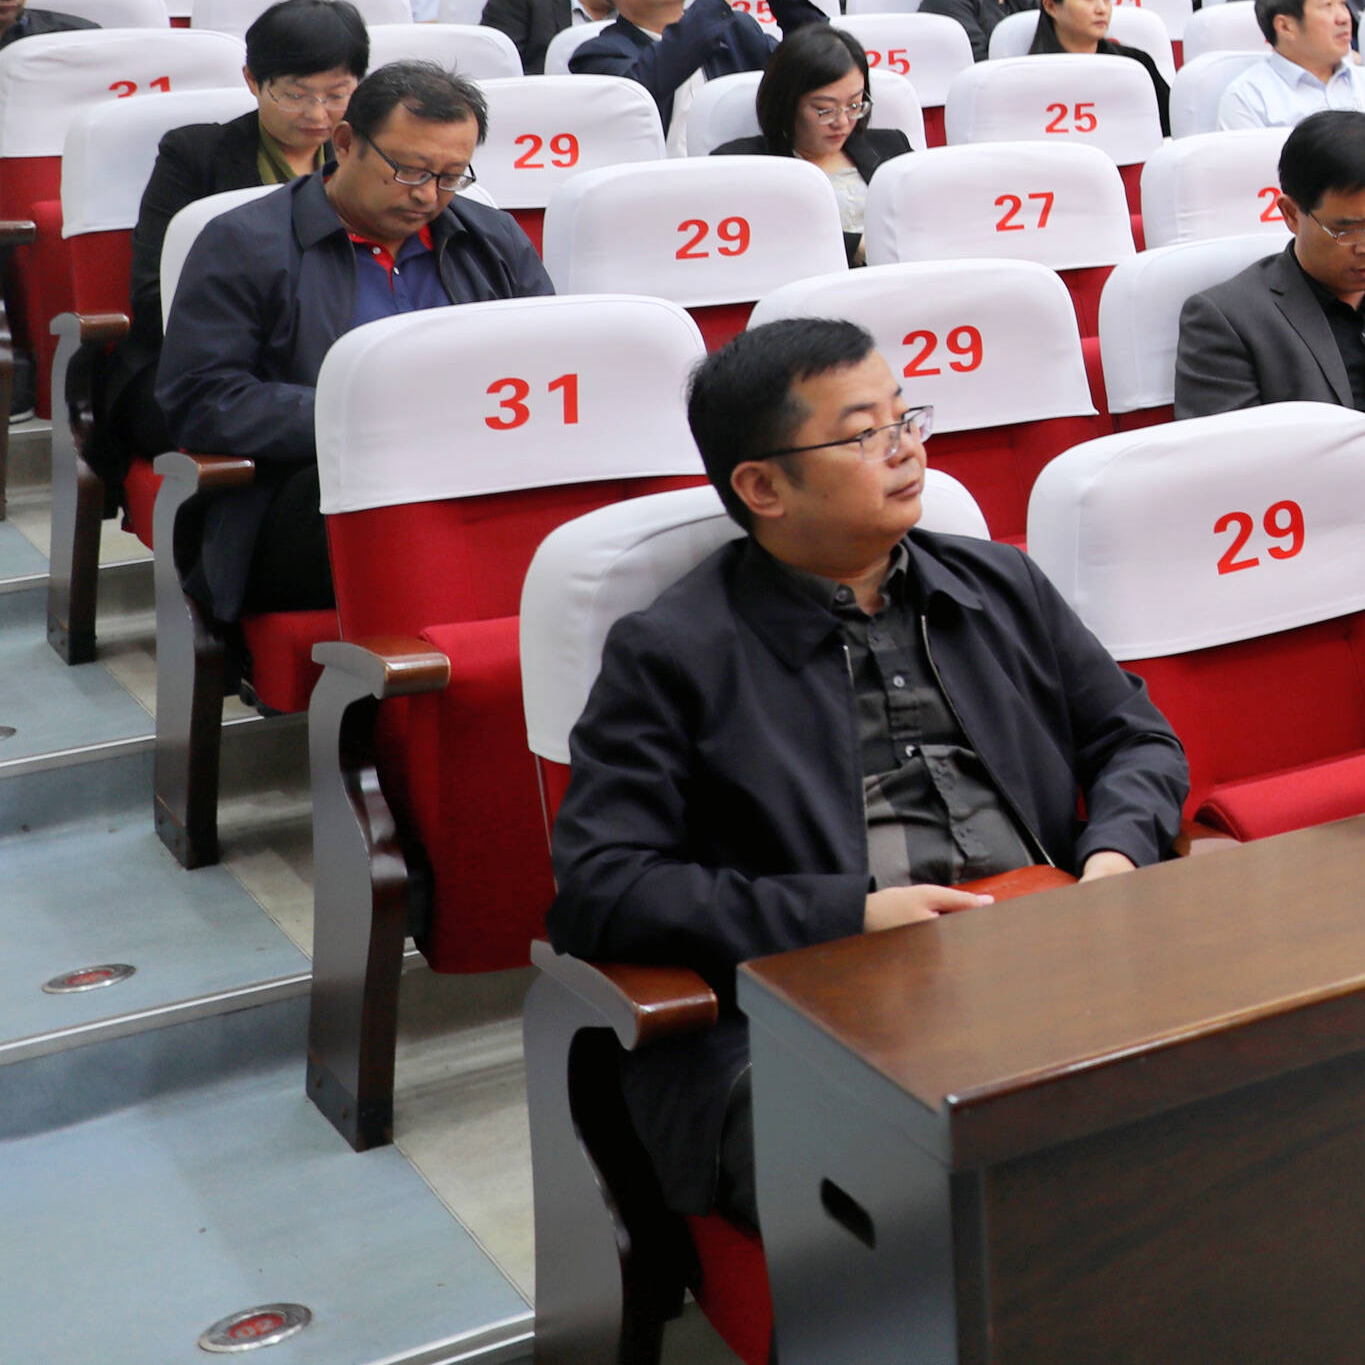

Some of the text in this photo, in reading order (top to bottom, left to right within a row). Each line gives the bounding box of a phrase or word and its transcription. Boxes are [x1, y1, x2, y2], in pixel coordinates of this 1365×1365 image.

[1045, 102, 1098, 134] 25
[514, 132, 580, 170] 29
[994, 191, 1055, 232] 27
[675, 216, 751, 261] 29
[901, 324, 984, 379] 29
[484, 373, 579, 431] 31
[1213, 499, 1306, 576] 29
